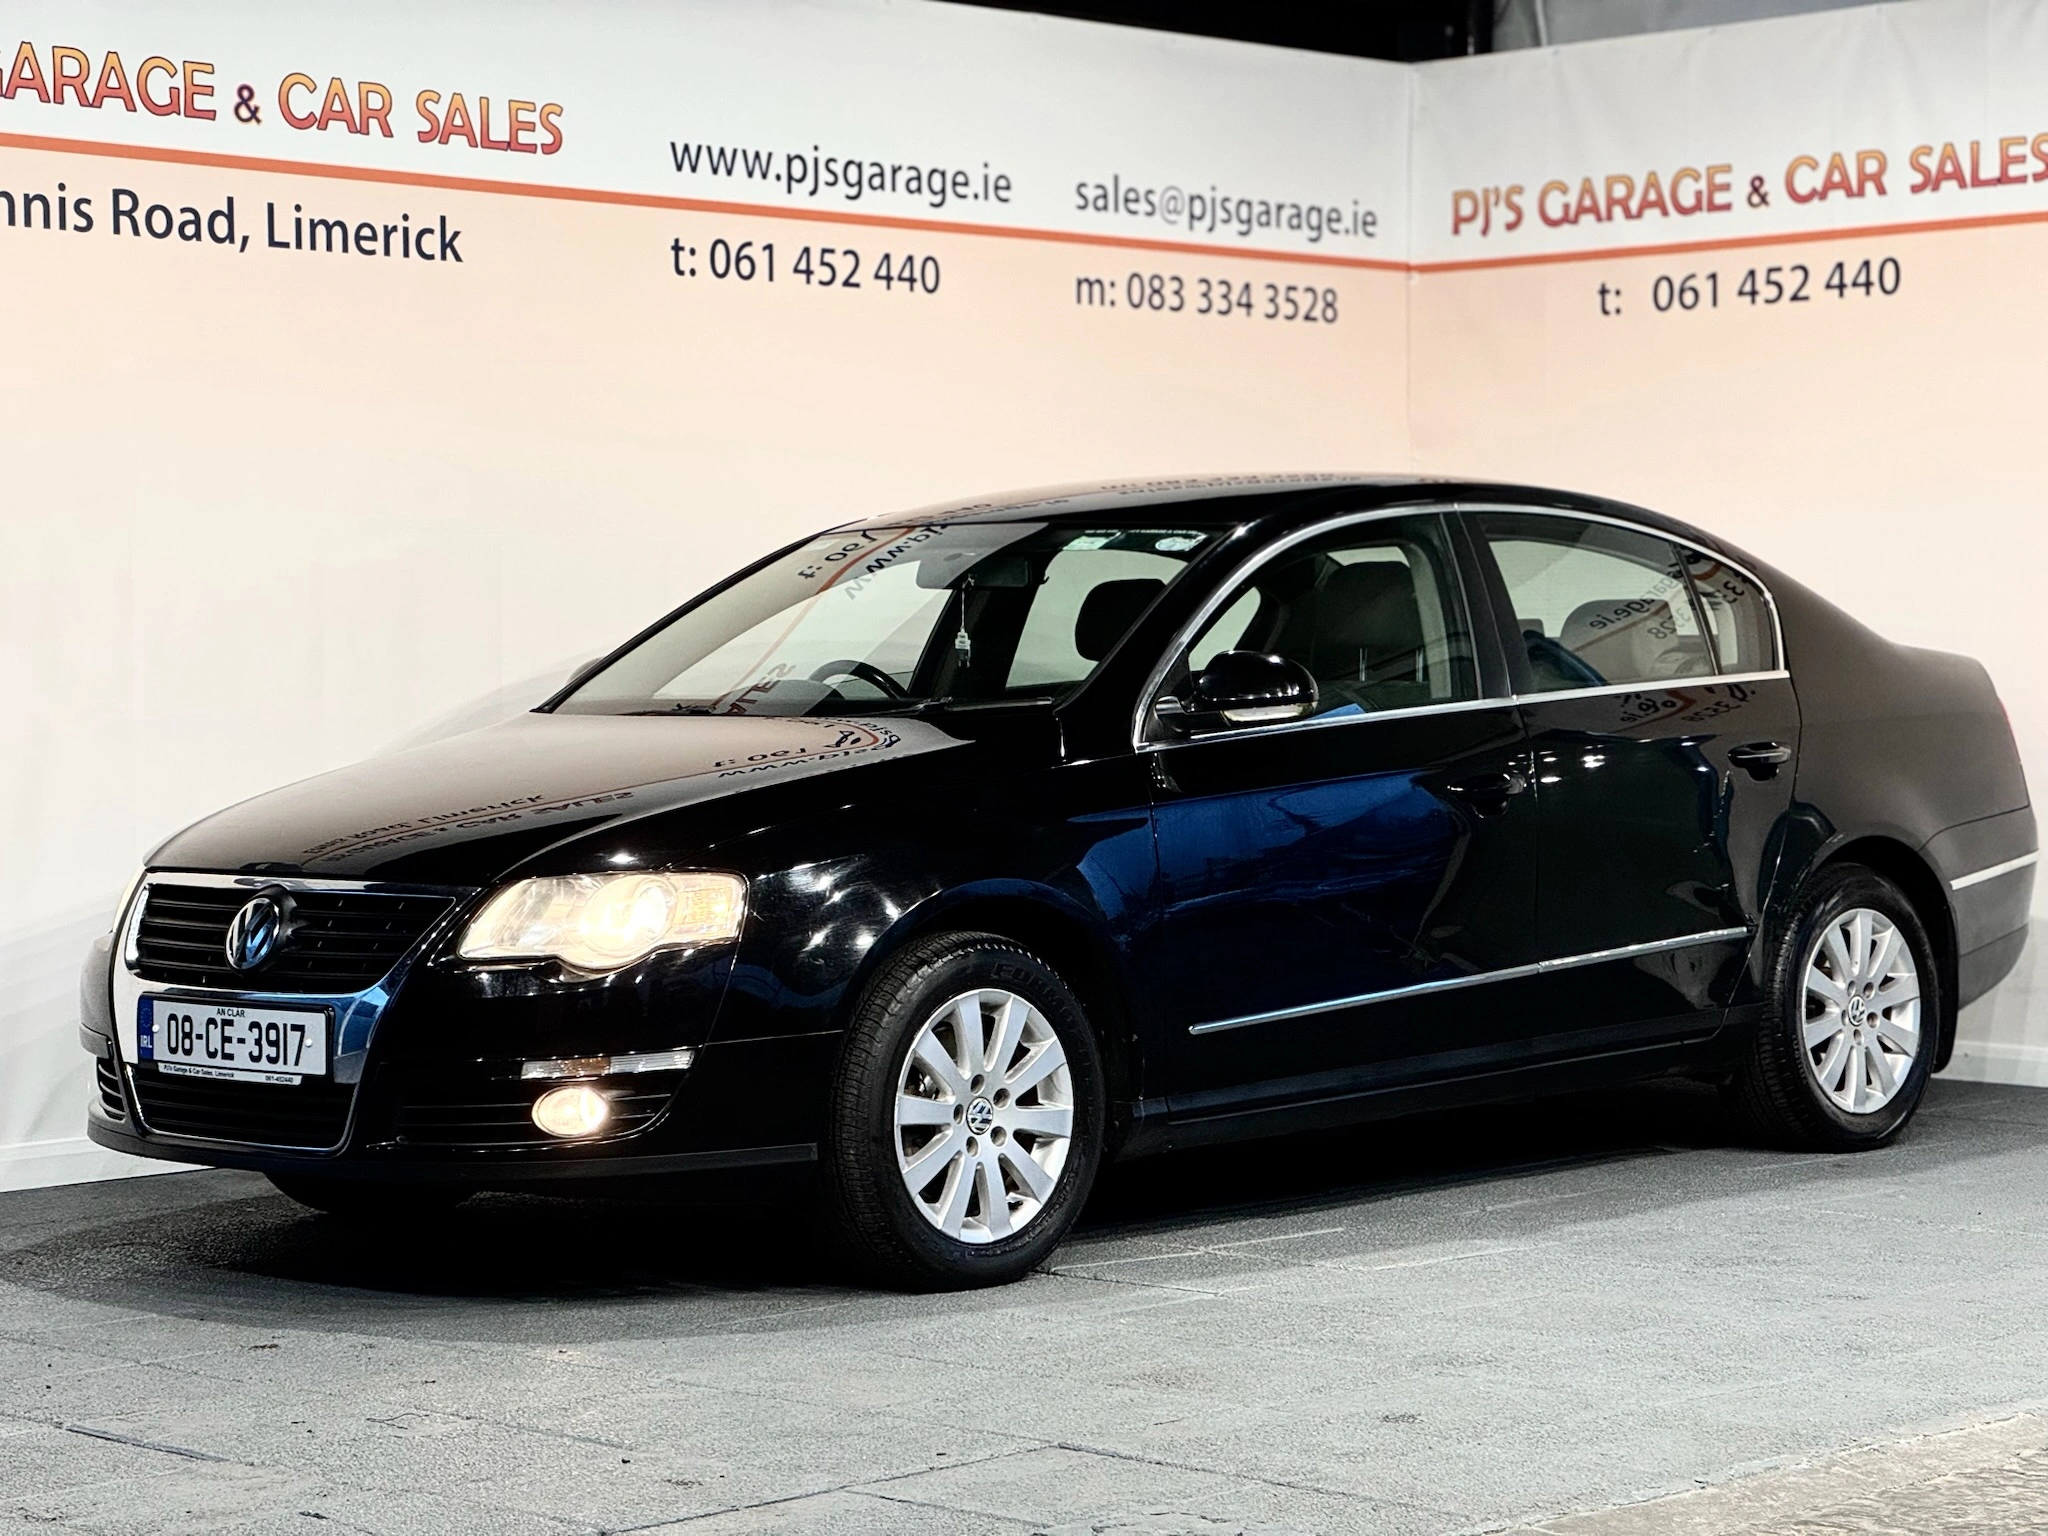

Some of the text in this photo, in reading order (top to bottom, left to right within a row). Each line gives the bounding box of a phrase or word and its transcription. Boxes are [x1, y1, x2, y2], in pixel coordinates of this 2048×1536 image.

[0, 41, 563, 155] ARAGE & CAR SALES
[671, 141, 1013, 208] www.pjsgarage.ie
[1453, 133, 2048, 236] PJ'S GARAGE & CAR SALES
[112, 189, 250, 253] Road,
[267, 202, 463, 262] Limerick
[1076, 175, 1379, 243] sales@pjsgarage.ie
[671, 238, 940, 294] t: 061 452 440
[1599, 258, 1900, 315] t: 061 452 440
[1077, 273, 1338, 324] m: 083 334 3528
[167, 1013, 306, 1067] 08-CE-3917
[216, 1007, 226, 1016] AN
[140, 1034, 153, 1049] IRL
